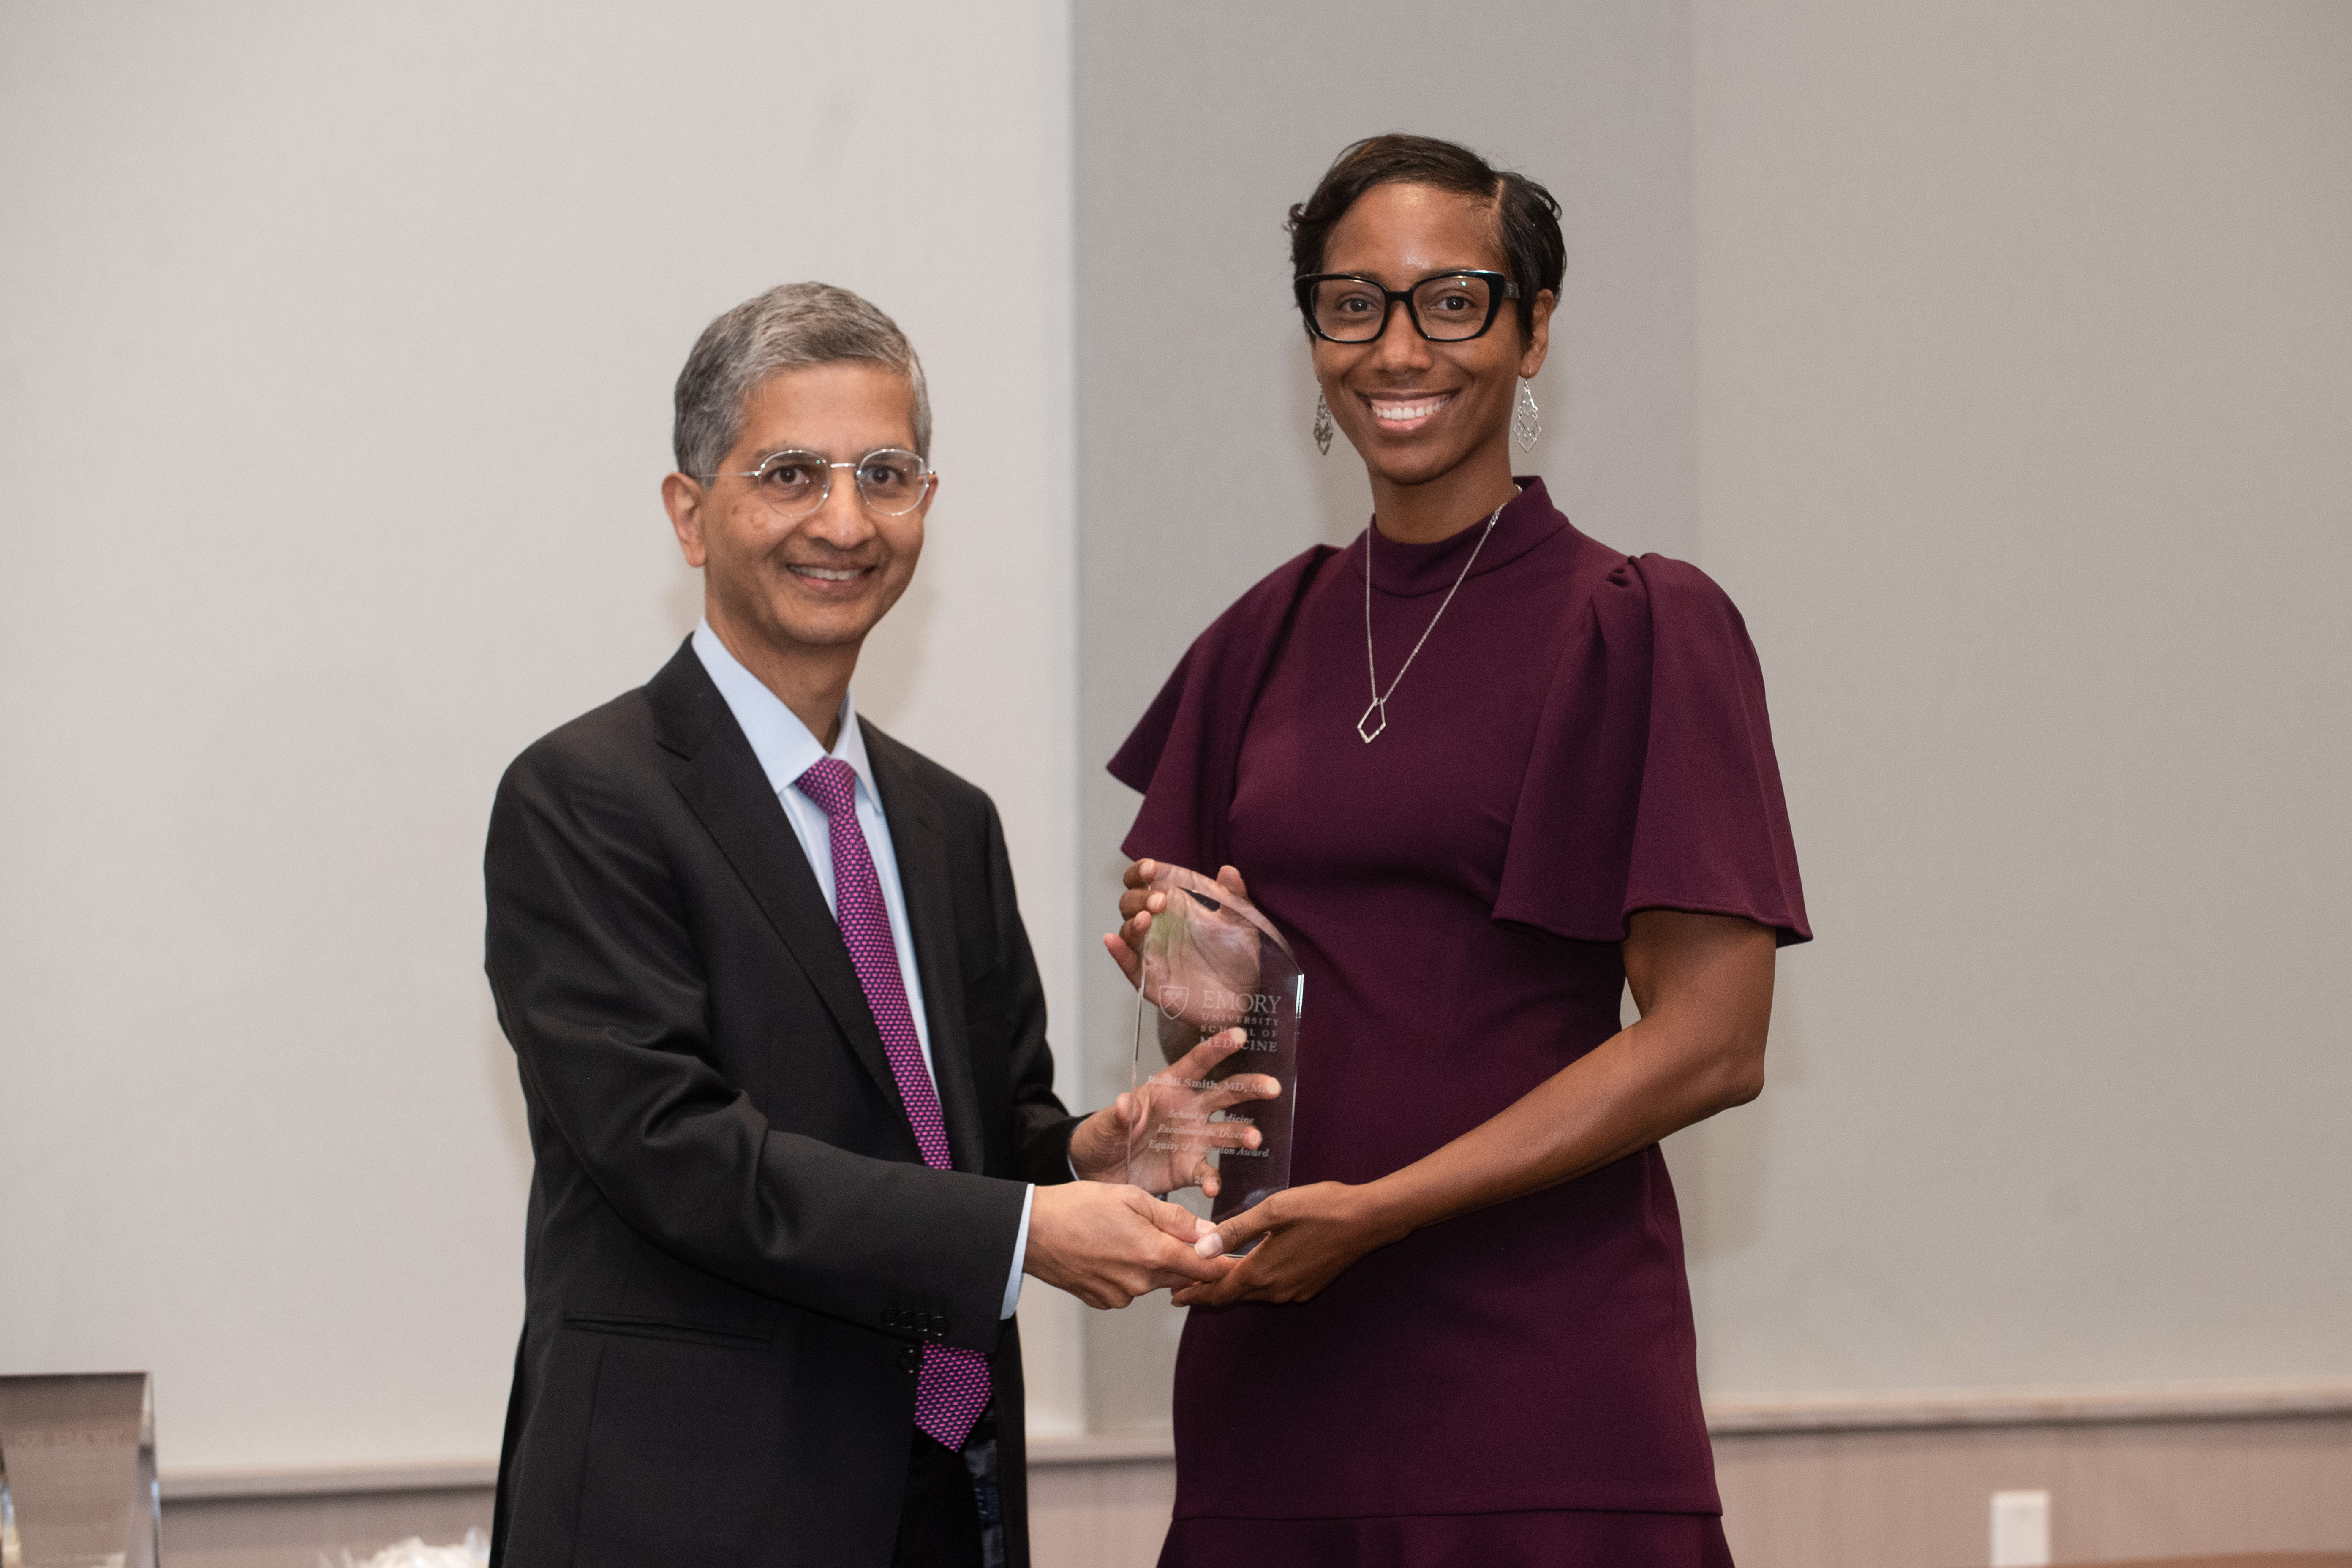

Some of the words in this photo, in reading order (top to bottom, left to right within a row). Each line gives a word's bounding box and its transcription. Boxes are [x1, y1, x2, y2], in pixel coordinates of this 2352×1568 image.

[1203, 990, 1282, 1014] EMORY
[1202, 1013, 1279, 1026] UNIVERSITY
[1200, 1025, 1256, 1037] SCHL
[1262, 1029, 1278, 1038] OF
[1224, 1081, 1247, 1093] MD,
[1214, 1112, 1255, 1124] dicine
[1148, 1139, 1179, 1153] Equity
[1236, 1148, 1270, 1157] Award
